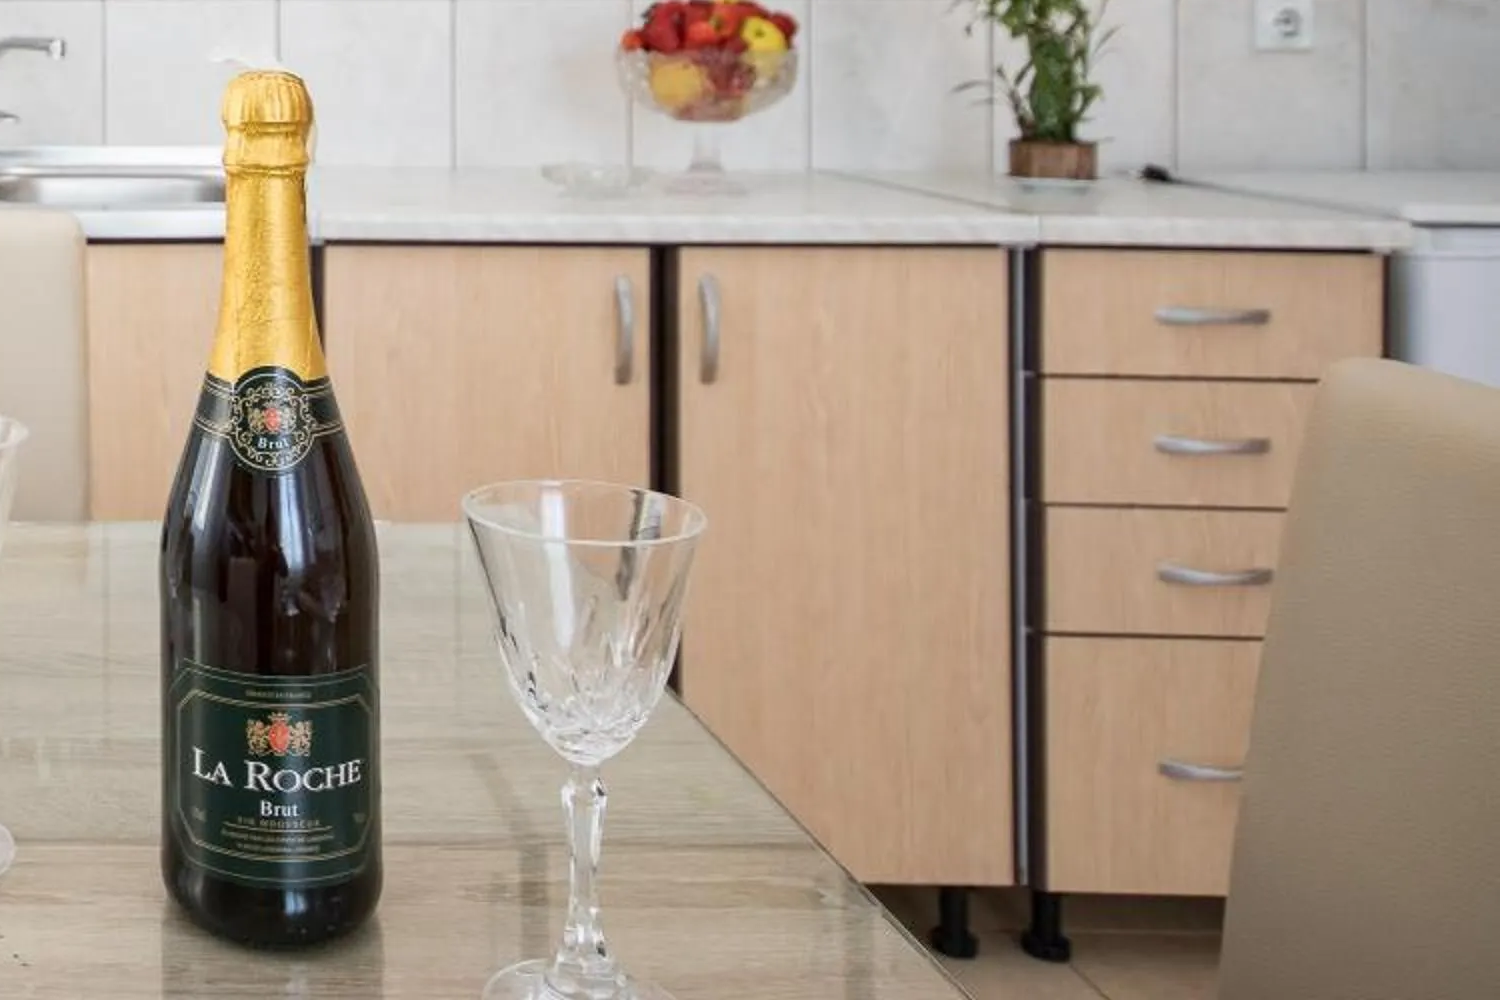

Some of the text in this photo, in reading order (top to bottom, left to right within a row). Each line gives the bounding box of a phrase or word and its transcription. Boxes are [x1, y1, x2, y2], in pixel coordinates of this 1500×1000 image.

[257, 437, 289, 449] Brut
[193, 747, 362, 793] LA ROCHE
[260, 801, 299, 818] Brut
